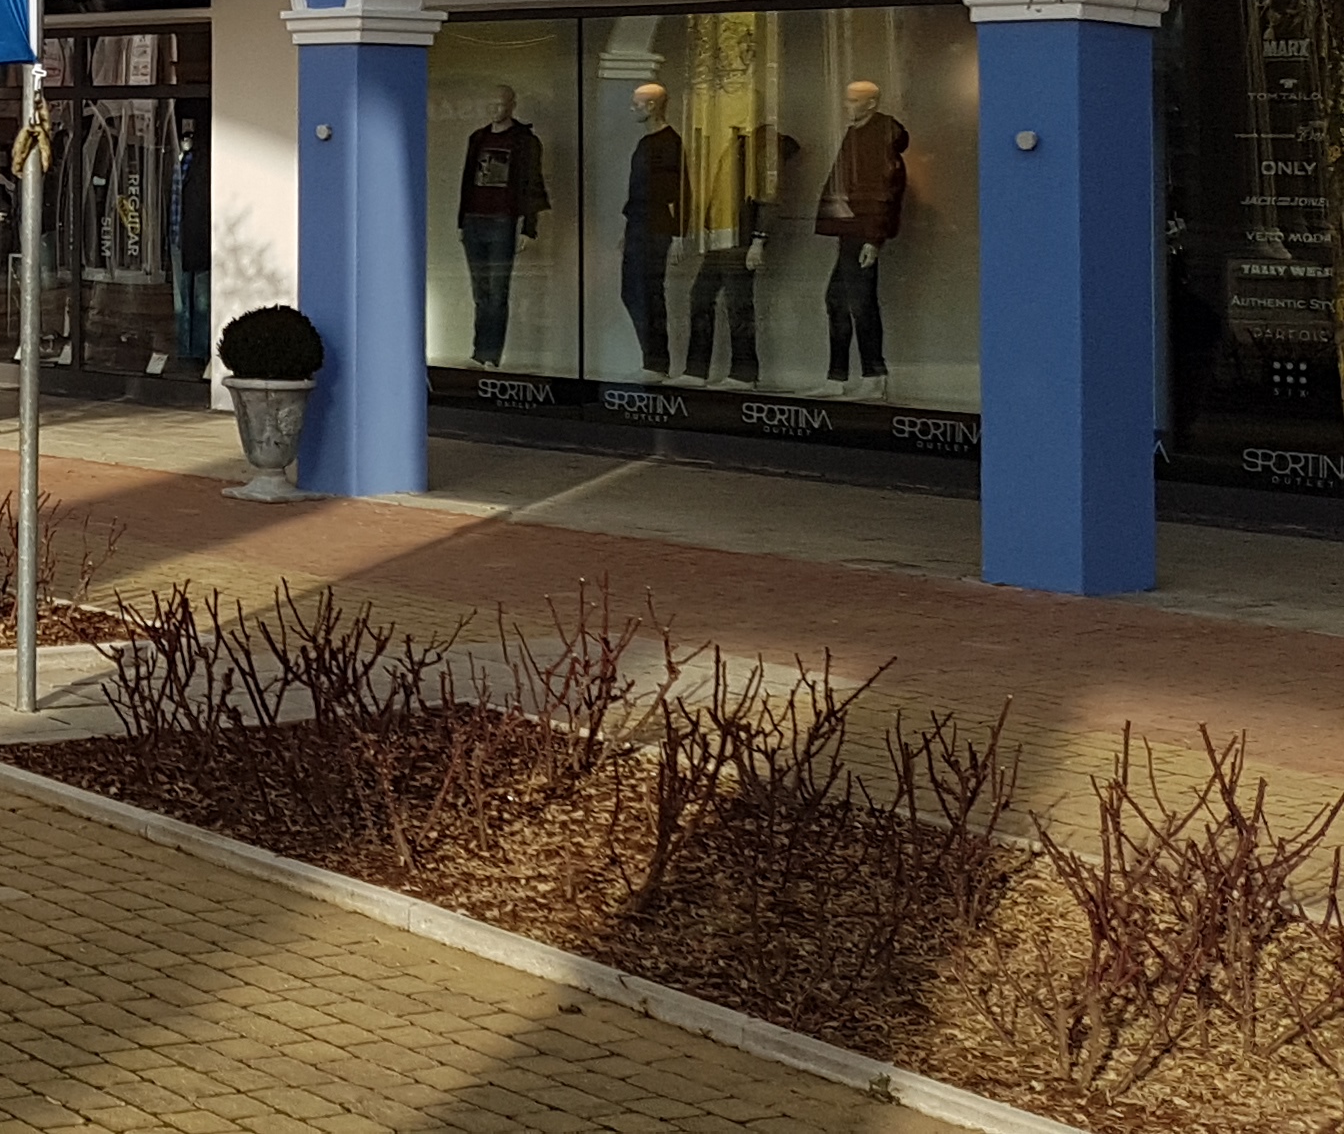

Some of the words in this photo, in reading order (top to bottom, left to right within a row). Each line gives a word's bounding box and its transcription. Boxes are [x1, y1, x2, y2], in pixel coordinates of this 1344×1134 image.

[1261, 160, 1317, 176] ONLY
[101, 216, 113, 257] SLIM
[477, 378, 556, 404] SPORTINA
[603, 389, 689, 417] SPORTINA
[624, 411, 669, 423] OUTLET
[741, 401, 833, 431] SPORTINA
[762, 424, 812, 437] OUTLET
[915, 439, 971, 454] OUTLET
[1271, 474, 1335, 490] OUTLET
